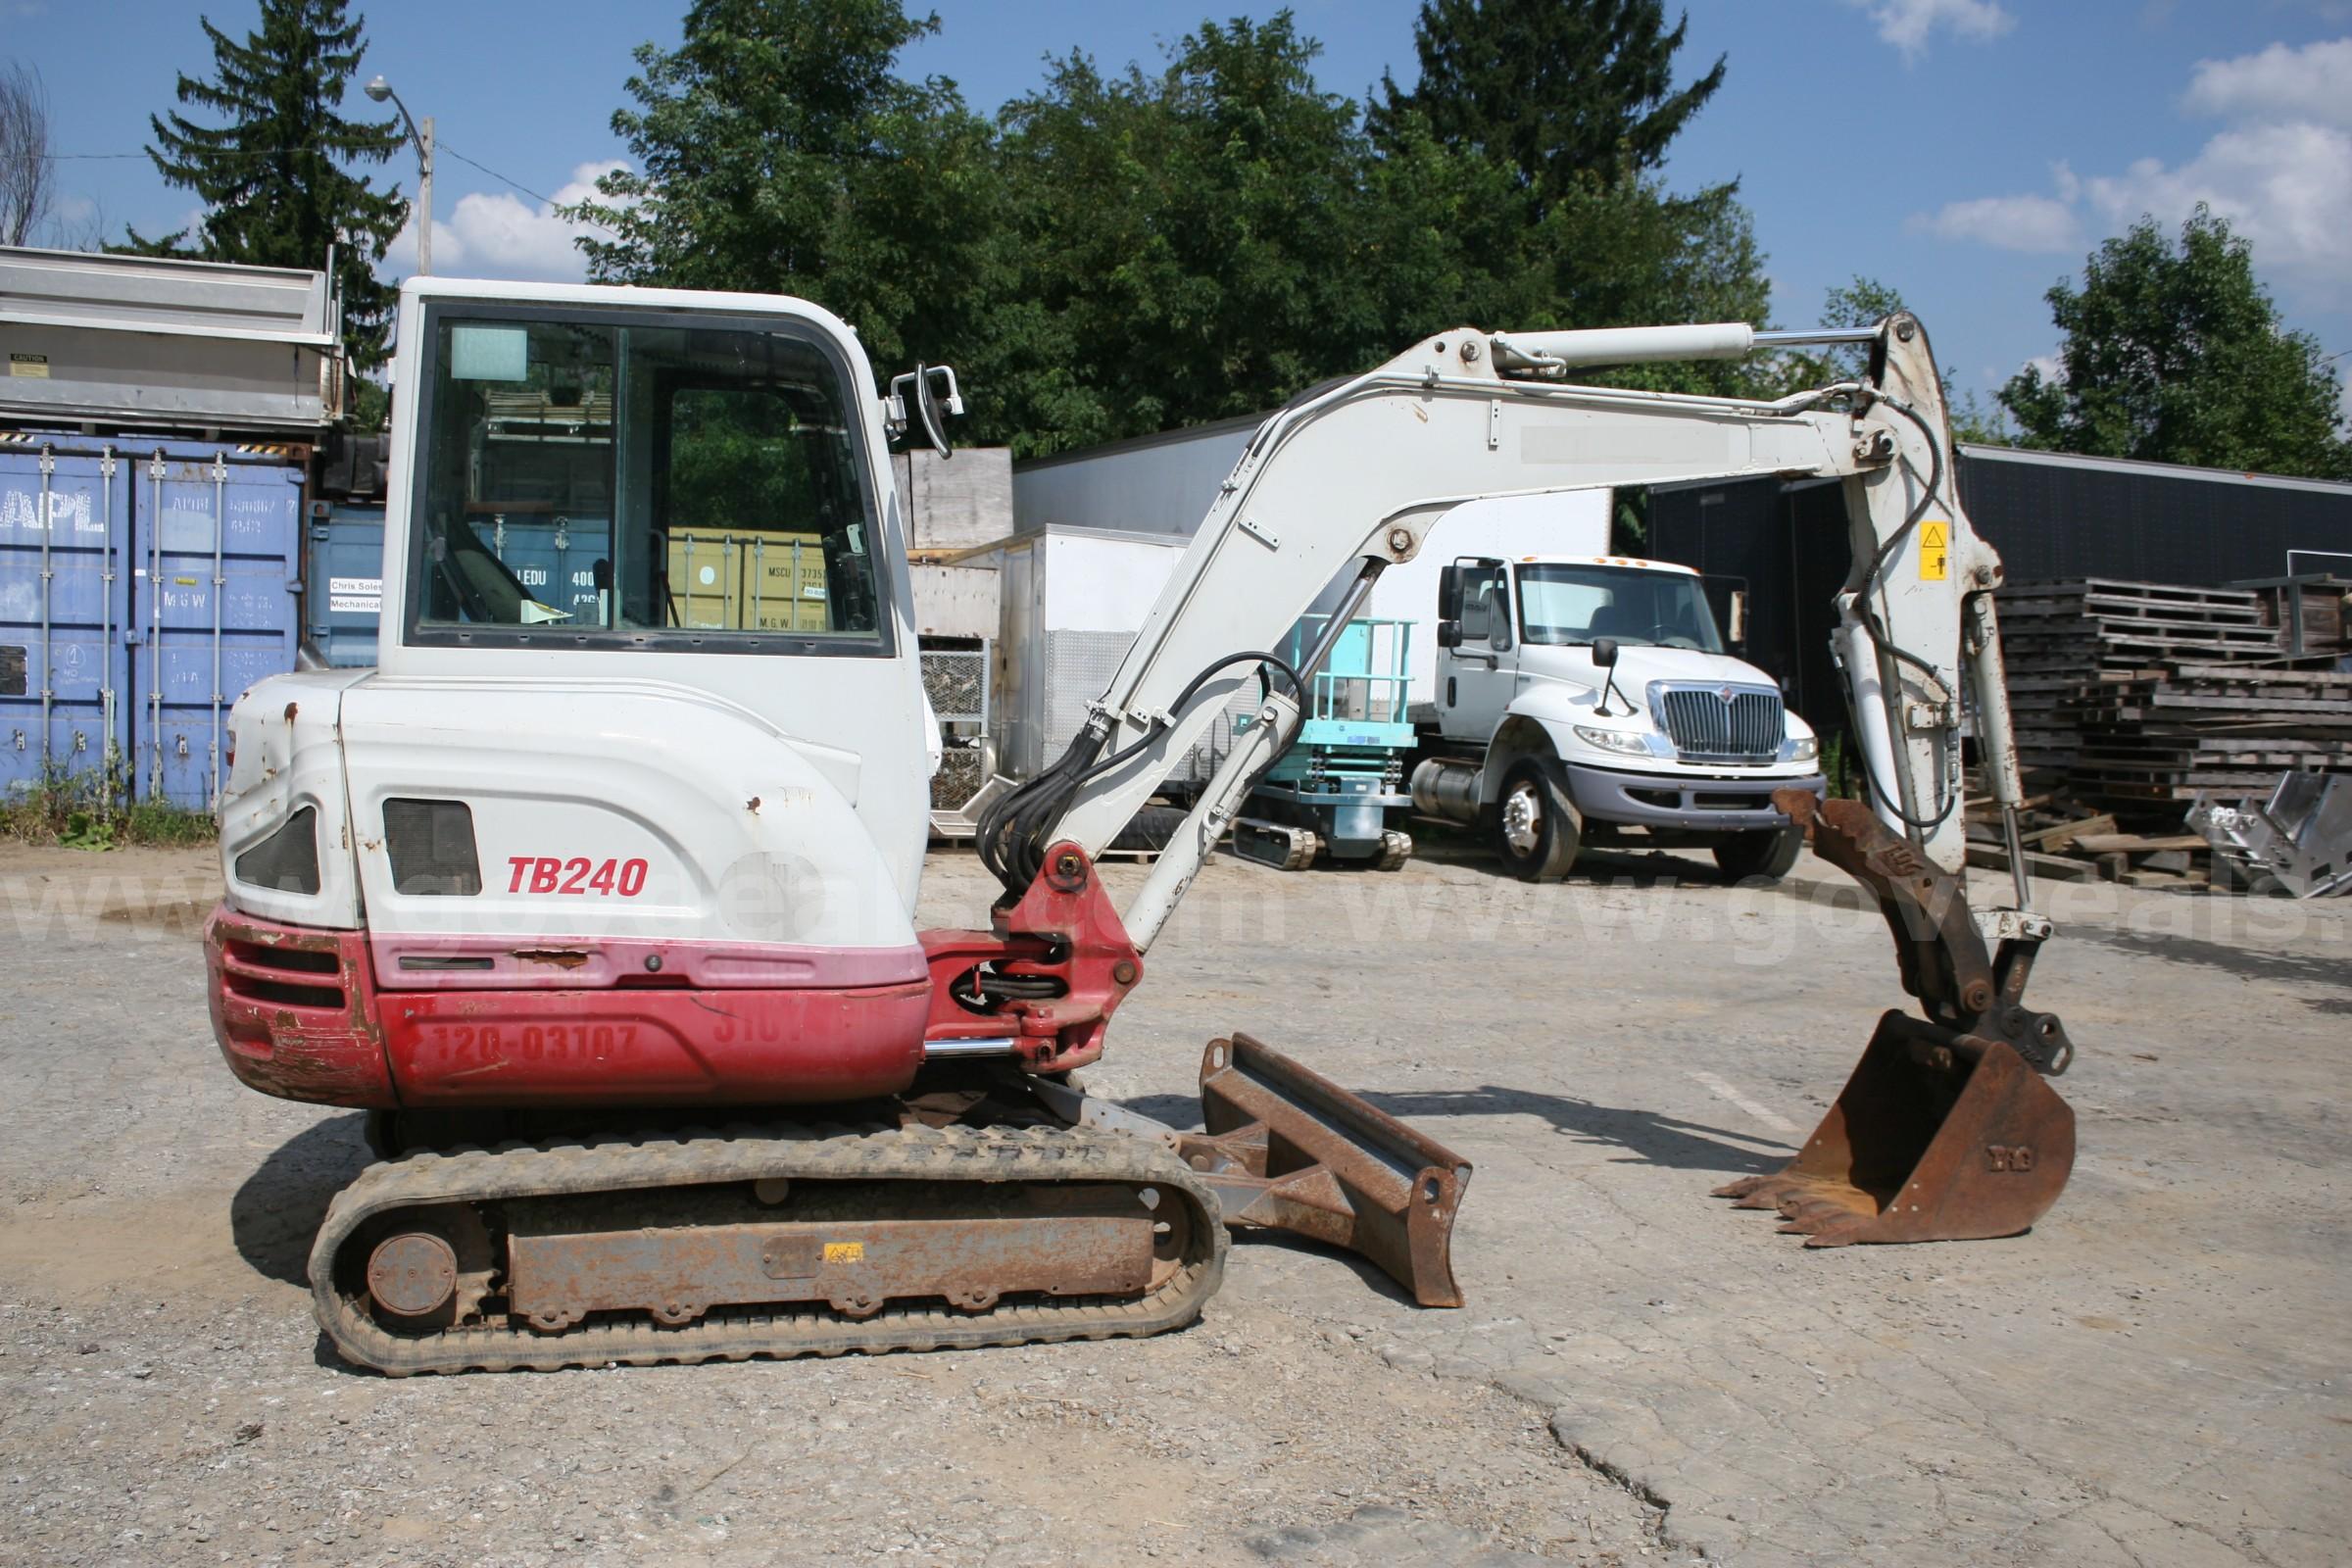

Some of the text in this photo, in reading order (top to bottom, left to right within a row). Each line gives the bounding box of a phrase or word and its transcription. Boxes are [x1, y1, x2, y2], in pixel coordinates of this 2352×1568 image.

[0, 490, 105, 532] APL
[517, 569, 546, 585] LEDU
[768, 566, 827, 579] MSCU 3735
[332, 581, 355, 590] Chris
[508, 857, 649, 897] TB240
